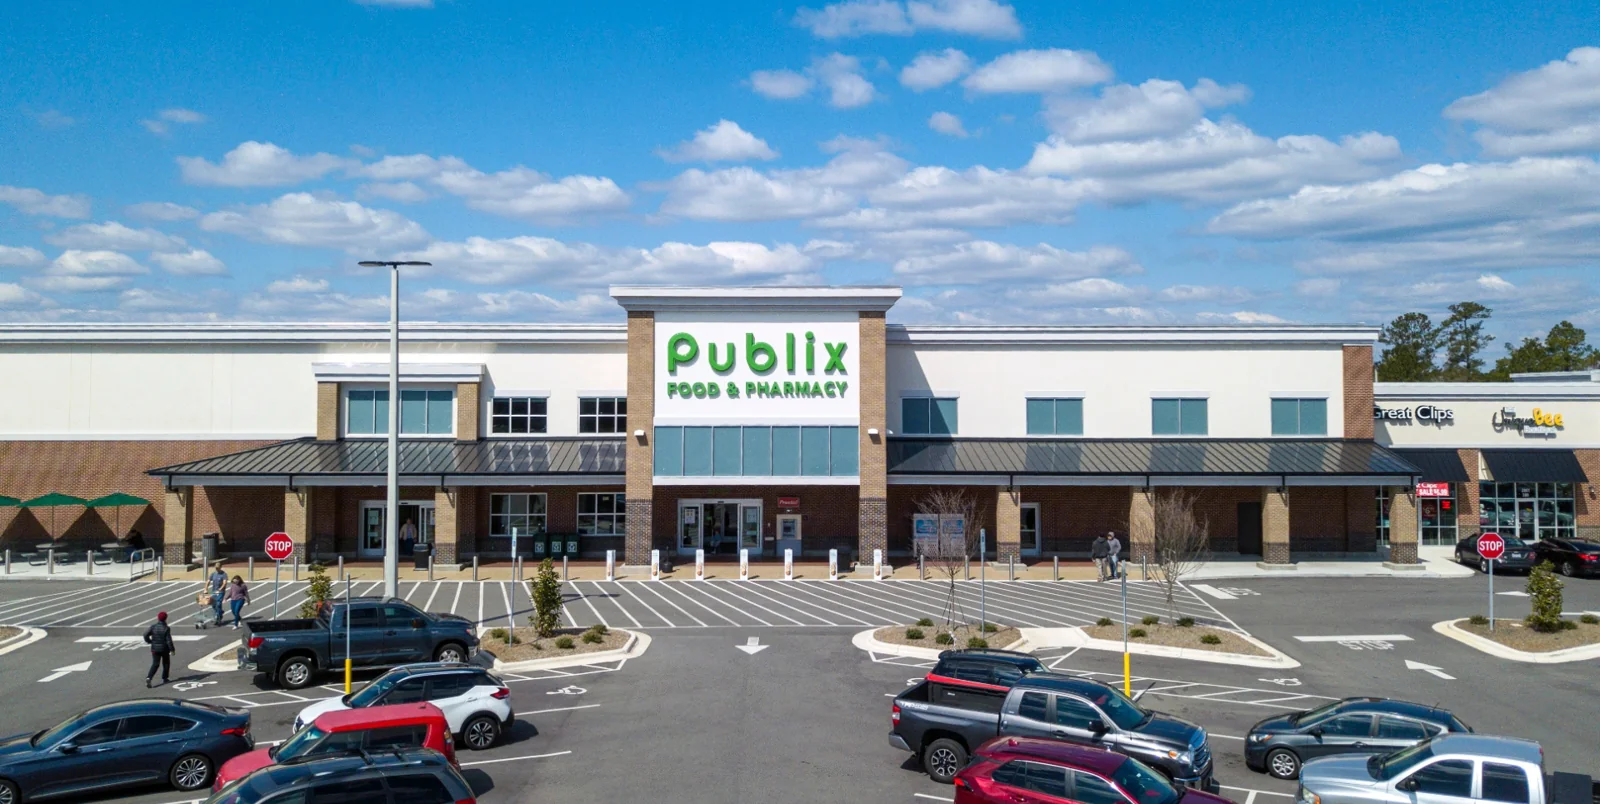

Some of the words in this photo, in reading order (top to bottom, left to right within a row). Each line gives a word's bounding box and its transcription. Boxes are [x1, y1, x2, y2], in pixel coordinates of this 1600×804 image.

[667, 331, 848, 374] Publix
[667, 382, 720, 398] FOOD
[726, 381, 739, 398] &
[745, 381, 848, 398] PHARMACY
[1416, 405, 1454, 423] Clips
[1533, 407, 1564, 427] Bee
[267, 540, 292, 552] STOP
[1479, 540, 1503, 552] STOP
